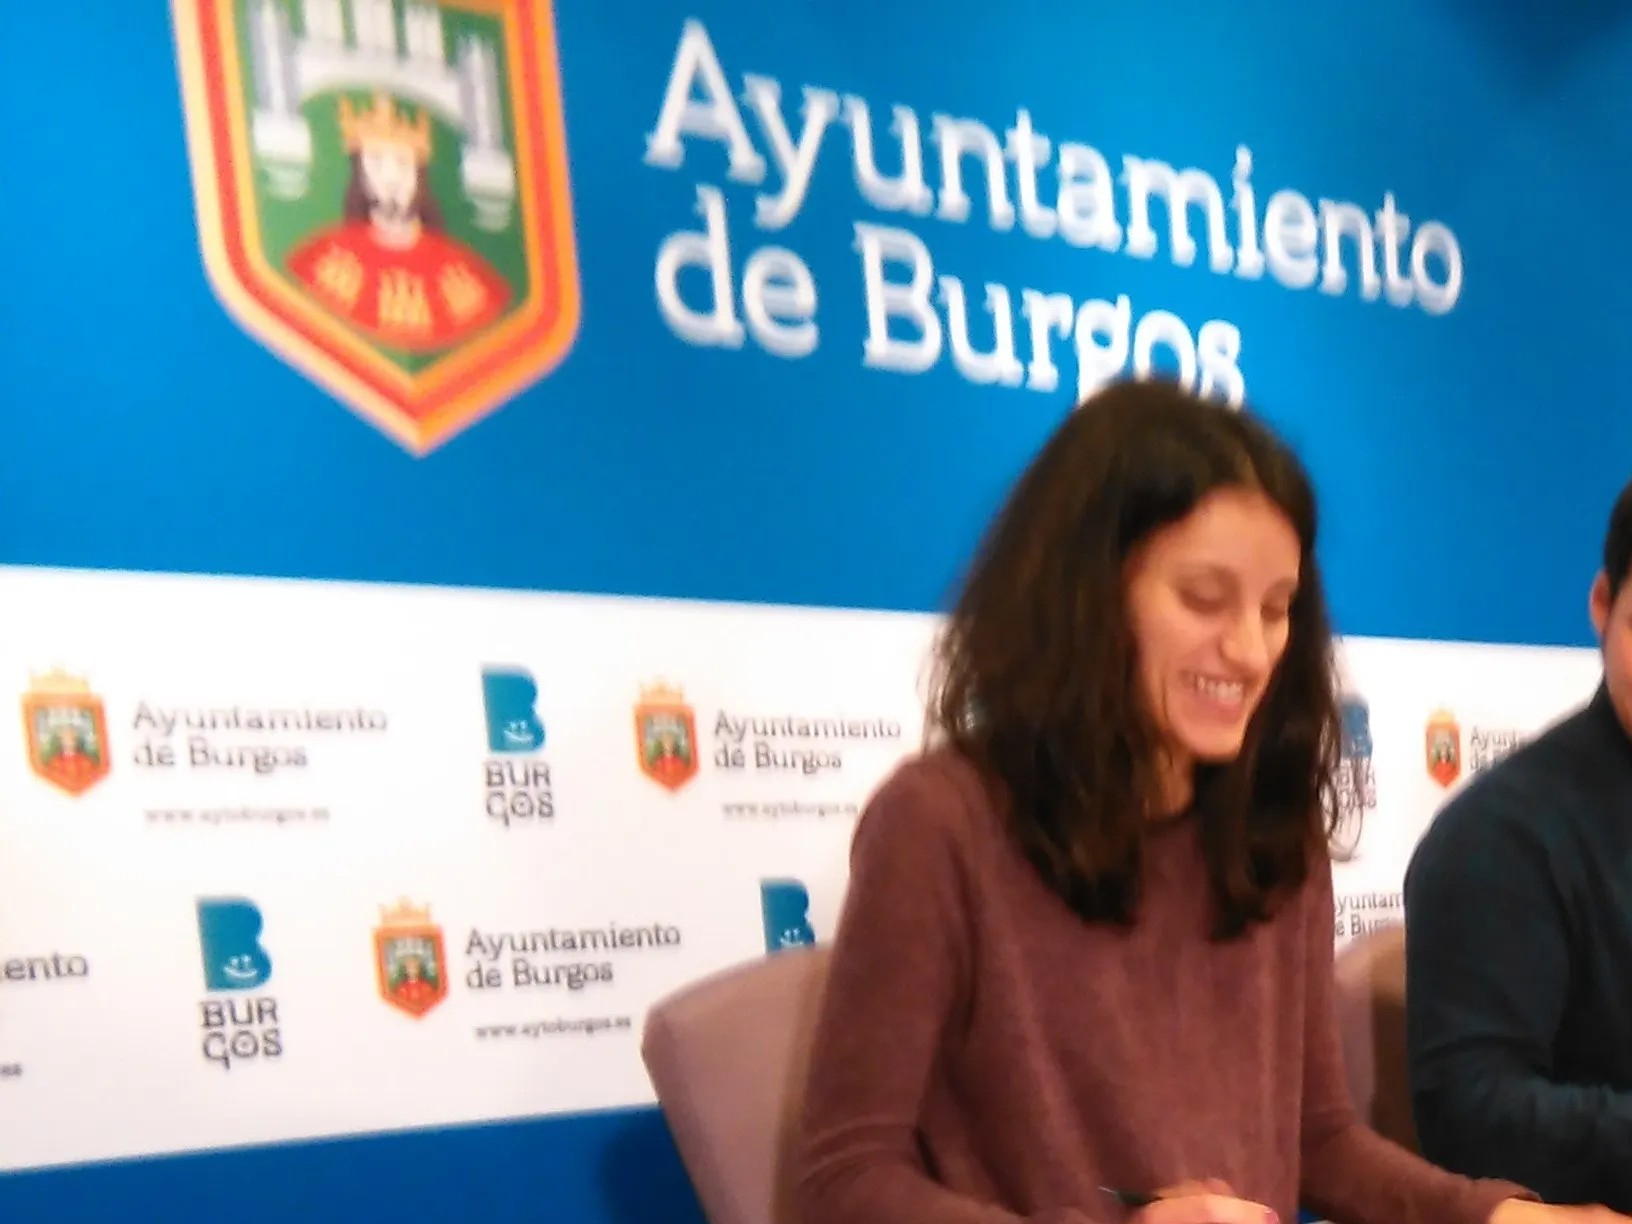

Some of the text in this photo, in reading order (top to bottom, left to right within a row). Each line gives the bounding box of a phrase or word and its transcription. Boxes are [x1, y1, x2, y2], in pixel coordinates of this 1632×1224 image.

[643, 17, 1464, 315] Ayuntamiento
[655, 184, 1246, 412] de Burgos
[133, 699, 388, 737] Ayuntamiento
[714, 709, 902, 741] Ayuntamiento
[133, 736, 309, 774] de Burgos
[714, 742, 844, 775] de Burgos
[484, 761, 552, 788] BUR
[465, 923, 682, 960] Ayuntamiento
[466, 958, 615, 991] de Burgos
[200, 997, 279, 1030] BUR
